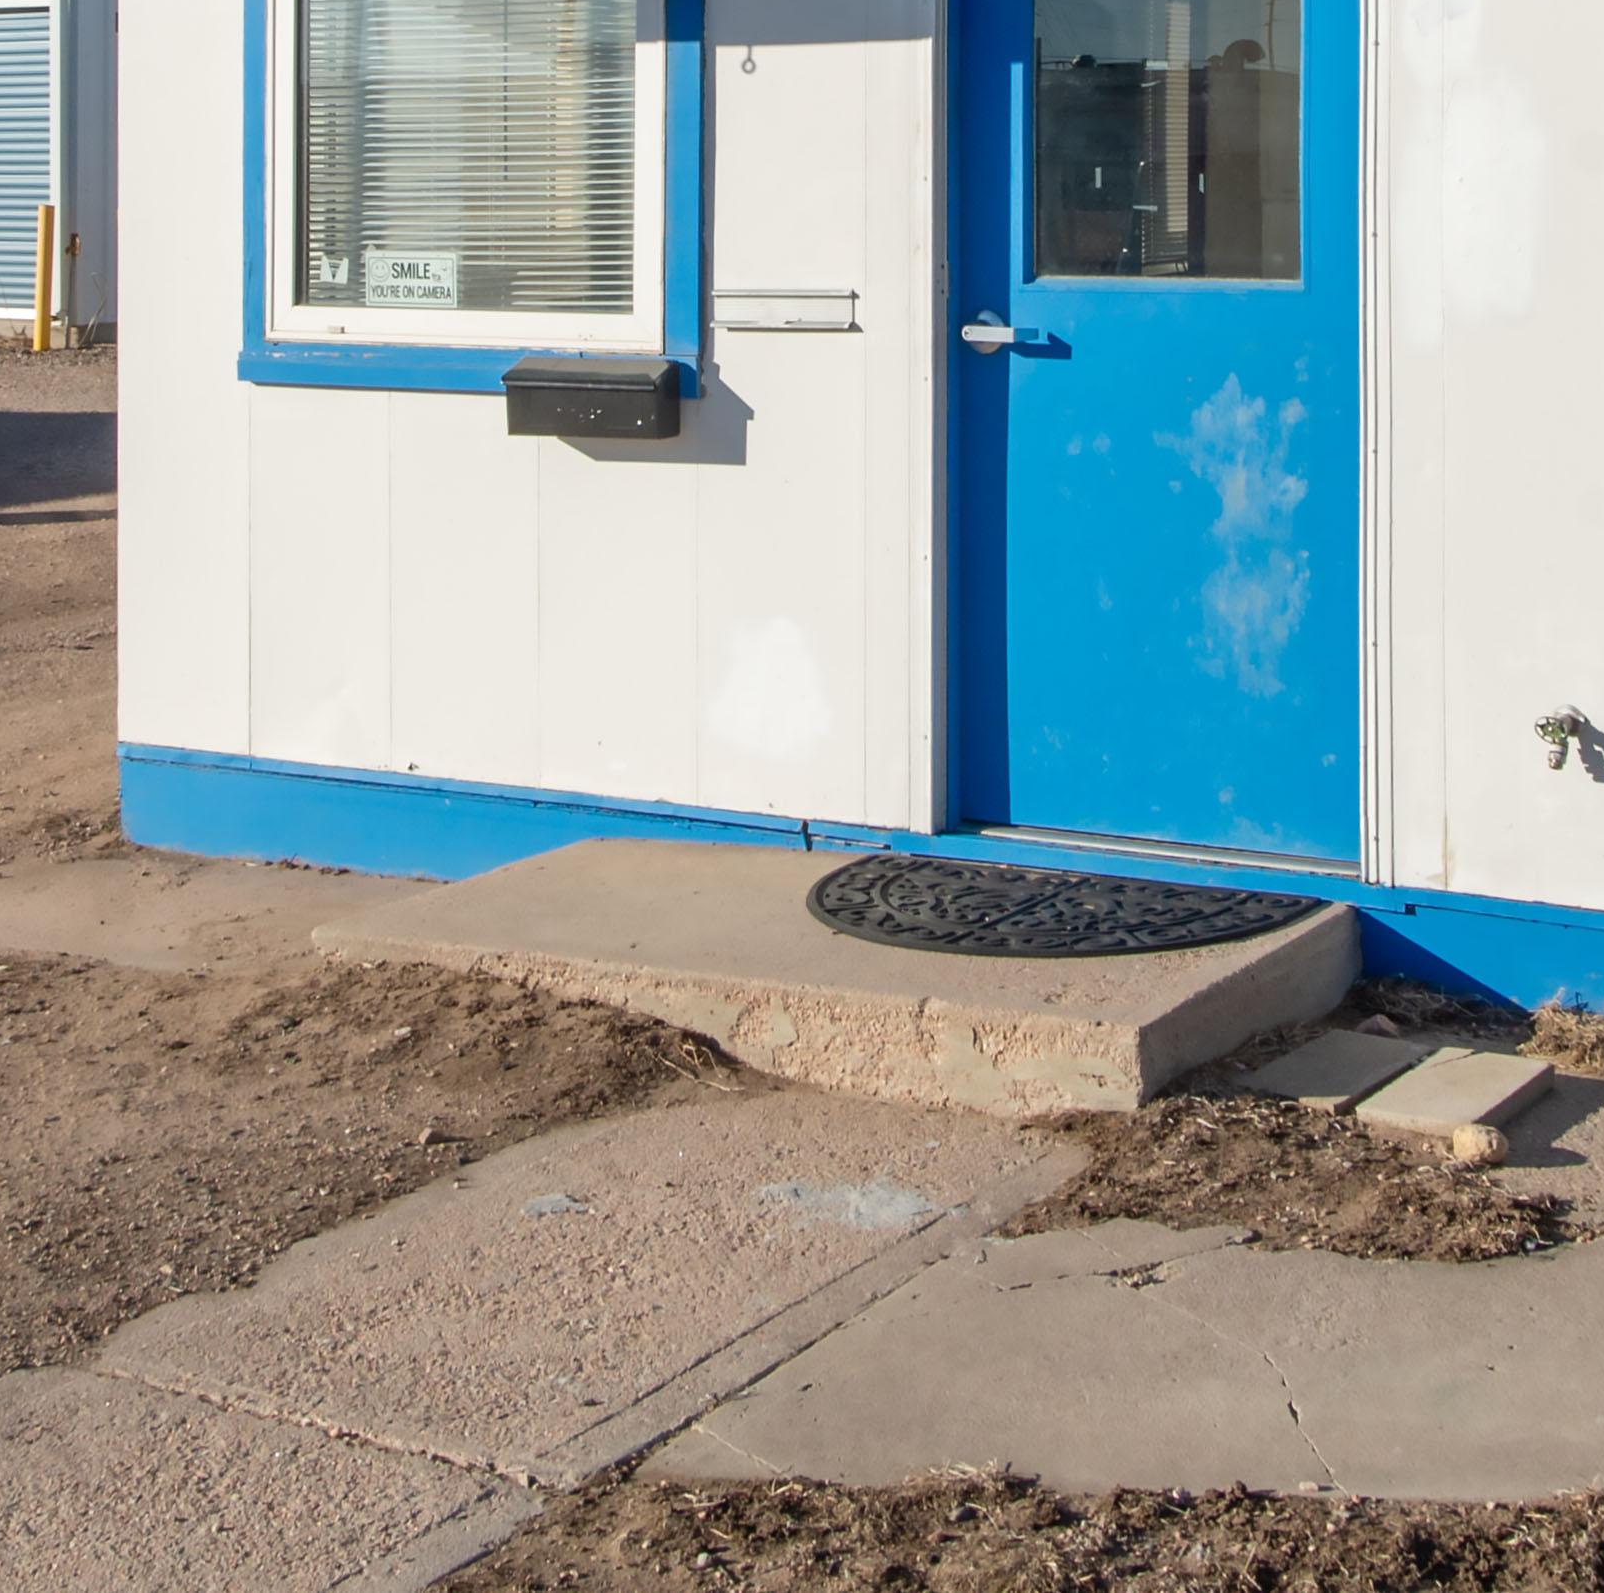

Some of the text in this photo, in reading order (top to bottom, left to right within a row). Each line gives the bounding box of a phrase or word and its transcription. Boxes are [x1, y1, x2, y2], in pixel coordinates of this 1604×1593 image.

[391, 262, 430, 279] SMILE
[371, 285, 452, 300] YOU'RE ON CAMERA
